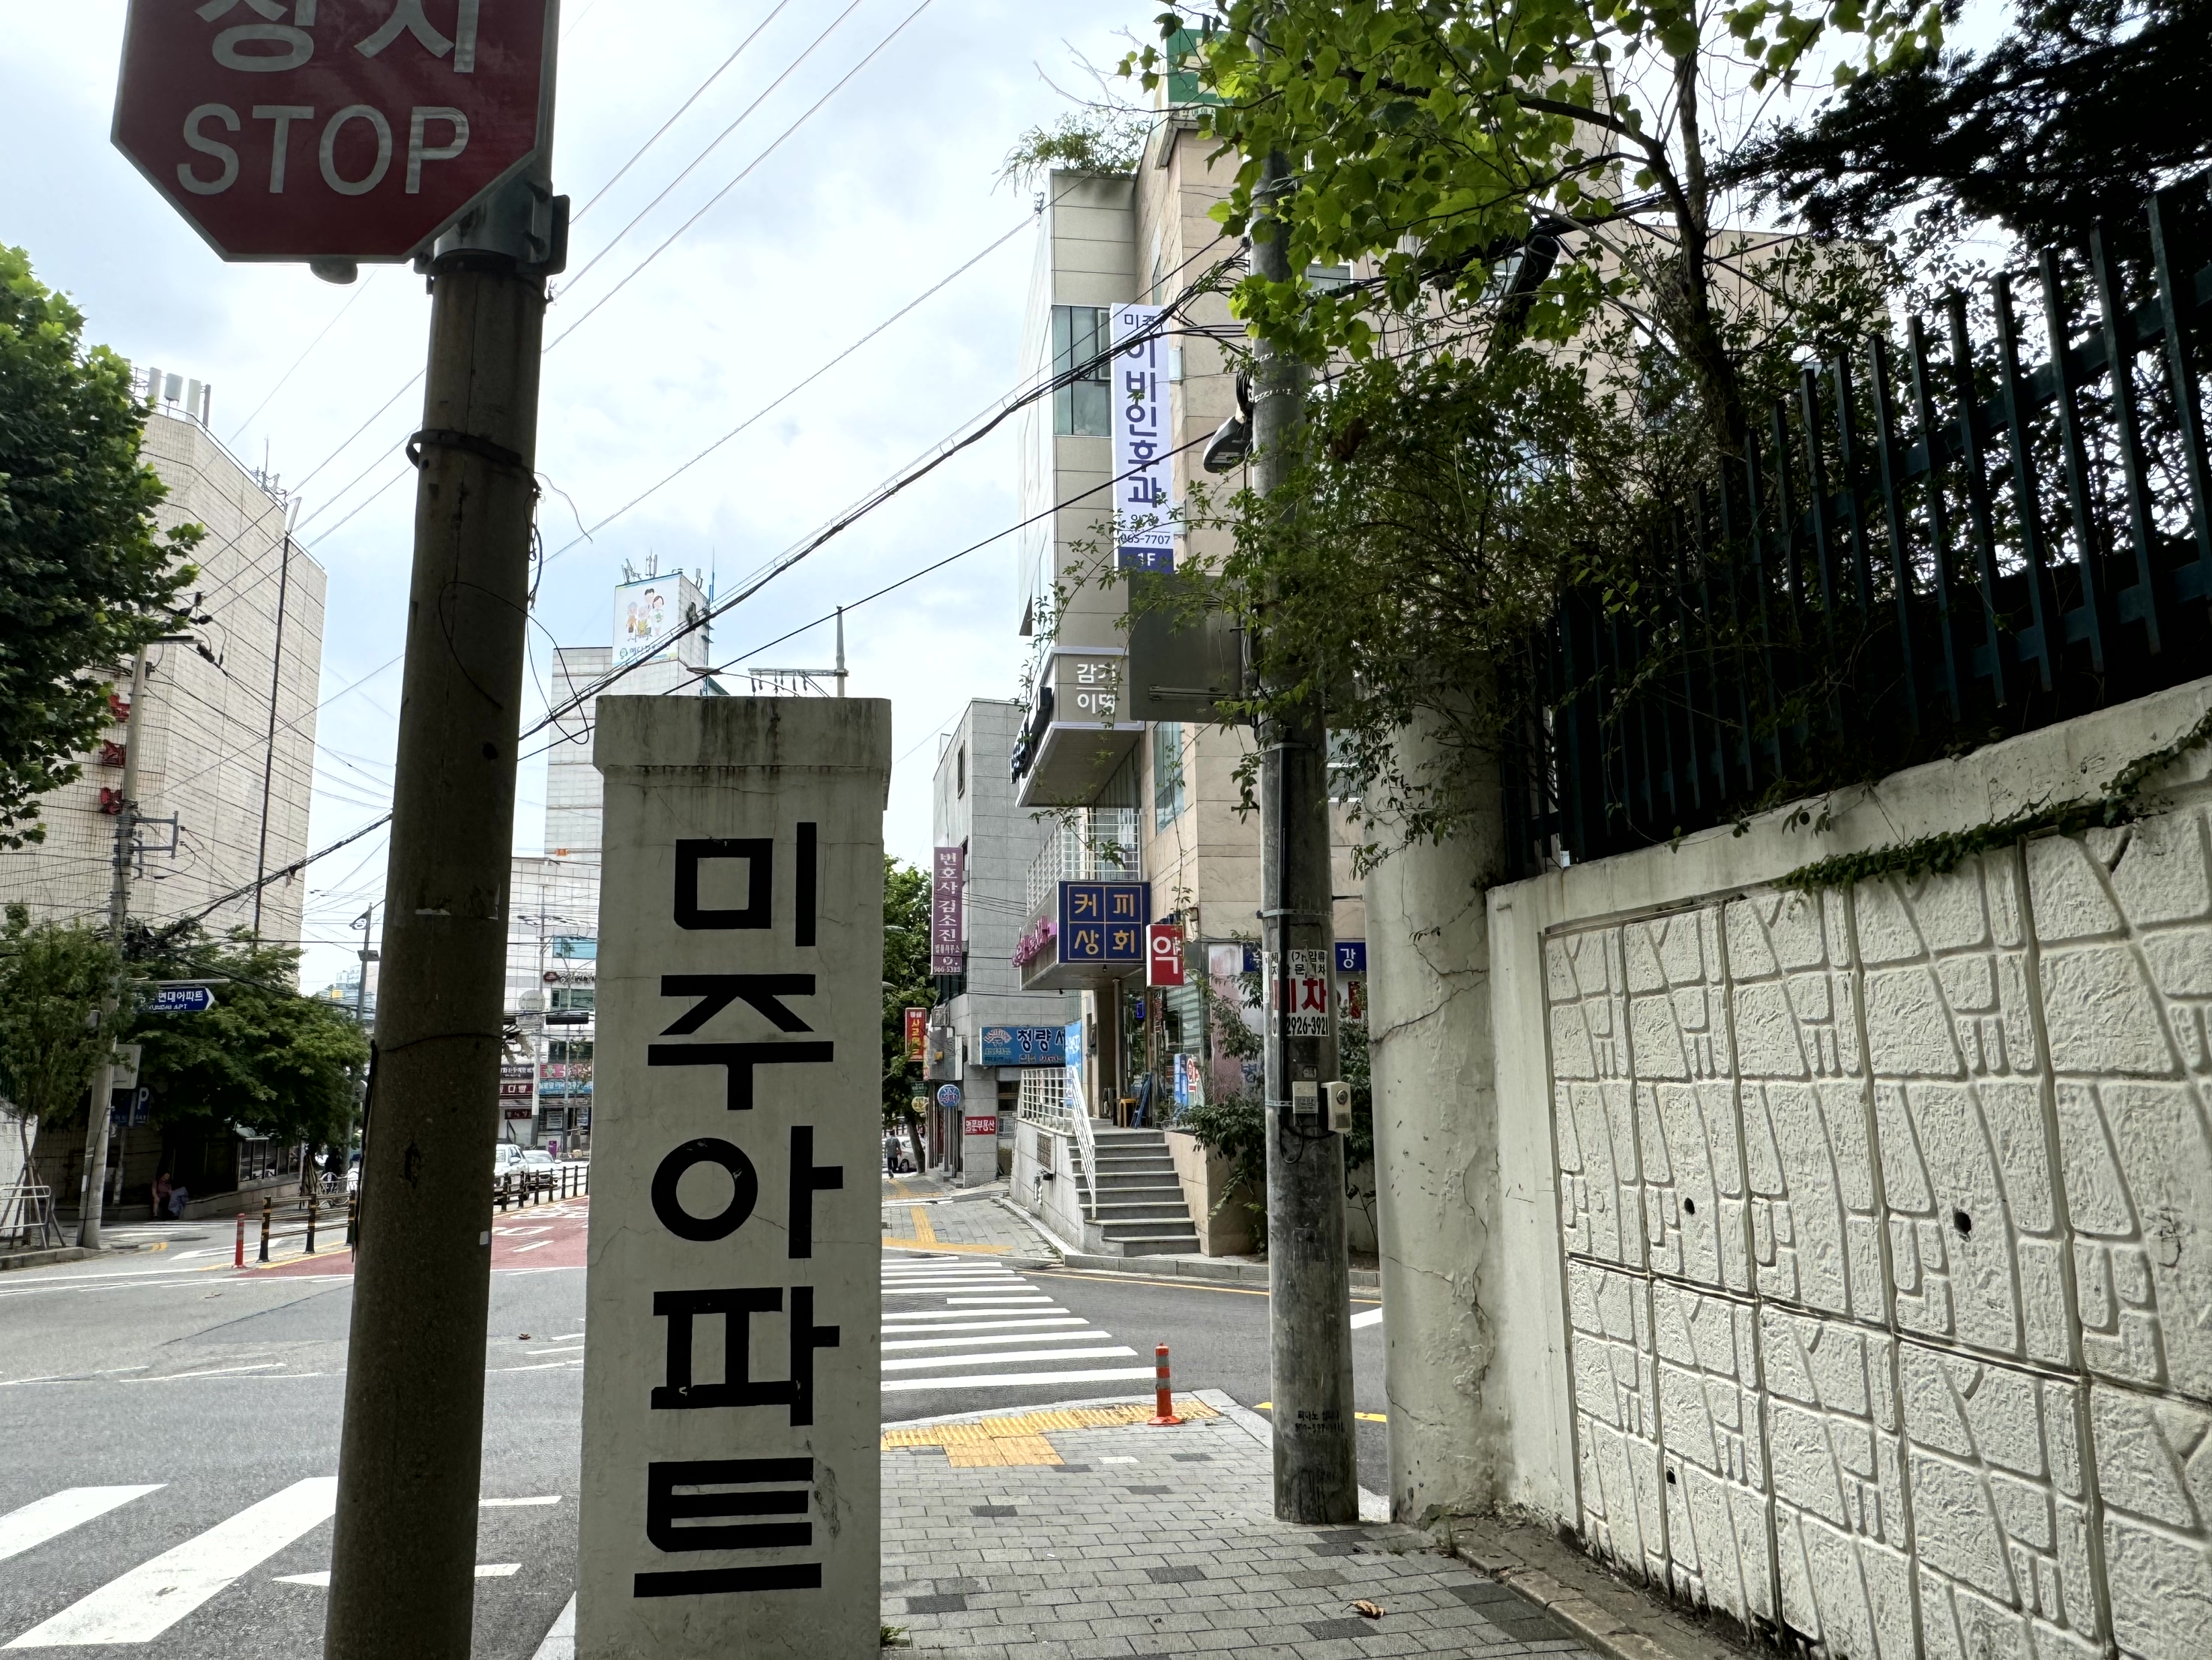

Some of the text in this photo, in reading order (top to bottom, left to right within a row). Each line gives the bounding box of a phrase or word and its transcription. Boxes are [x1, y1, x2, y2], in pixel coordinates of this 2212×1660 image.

[177, 103, 470, 196] STOP
[1125, 334, 1162, 508] 이비인후과
[1137, 553, 1156, 566] 1F
[938, 852, 958, 894] 변호사
[1074, 893, 1135, 917] 커피
[1074, 930, 1136, 955] 상회
[1152, 936, 1181, 975] 약
[633, 822, 844, 1598] 미주아파트
